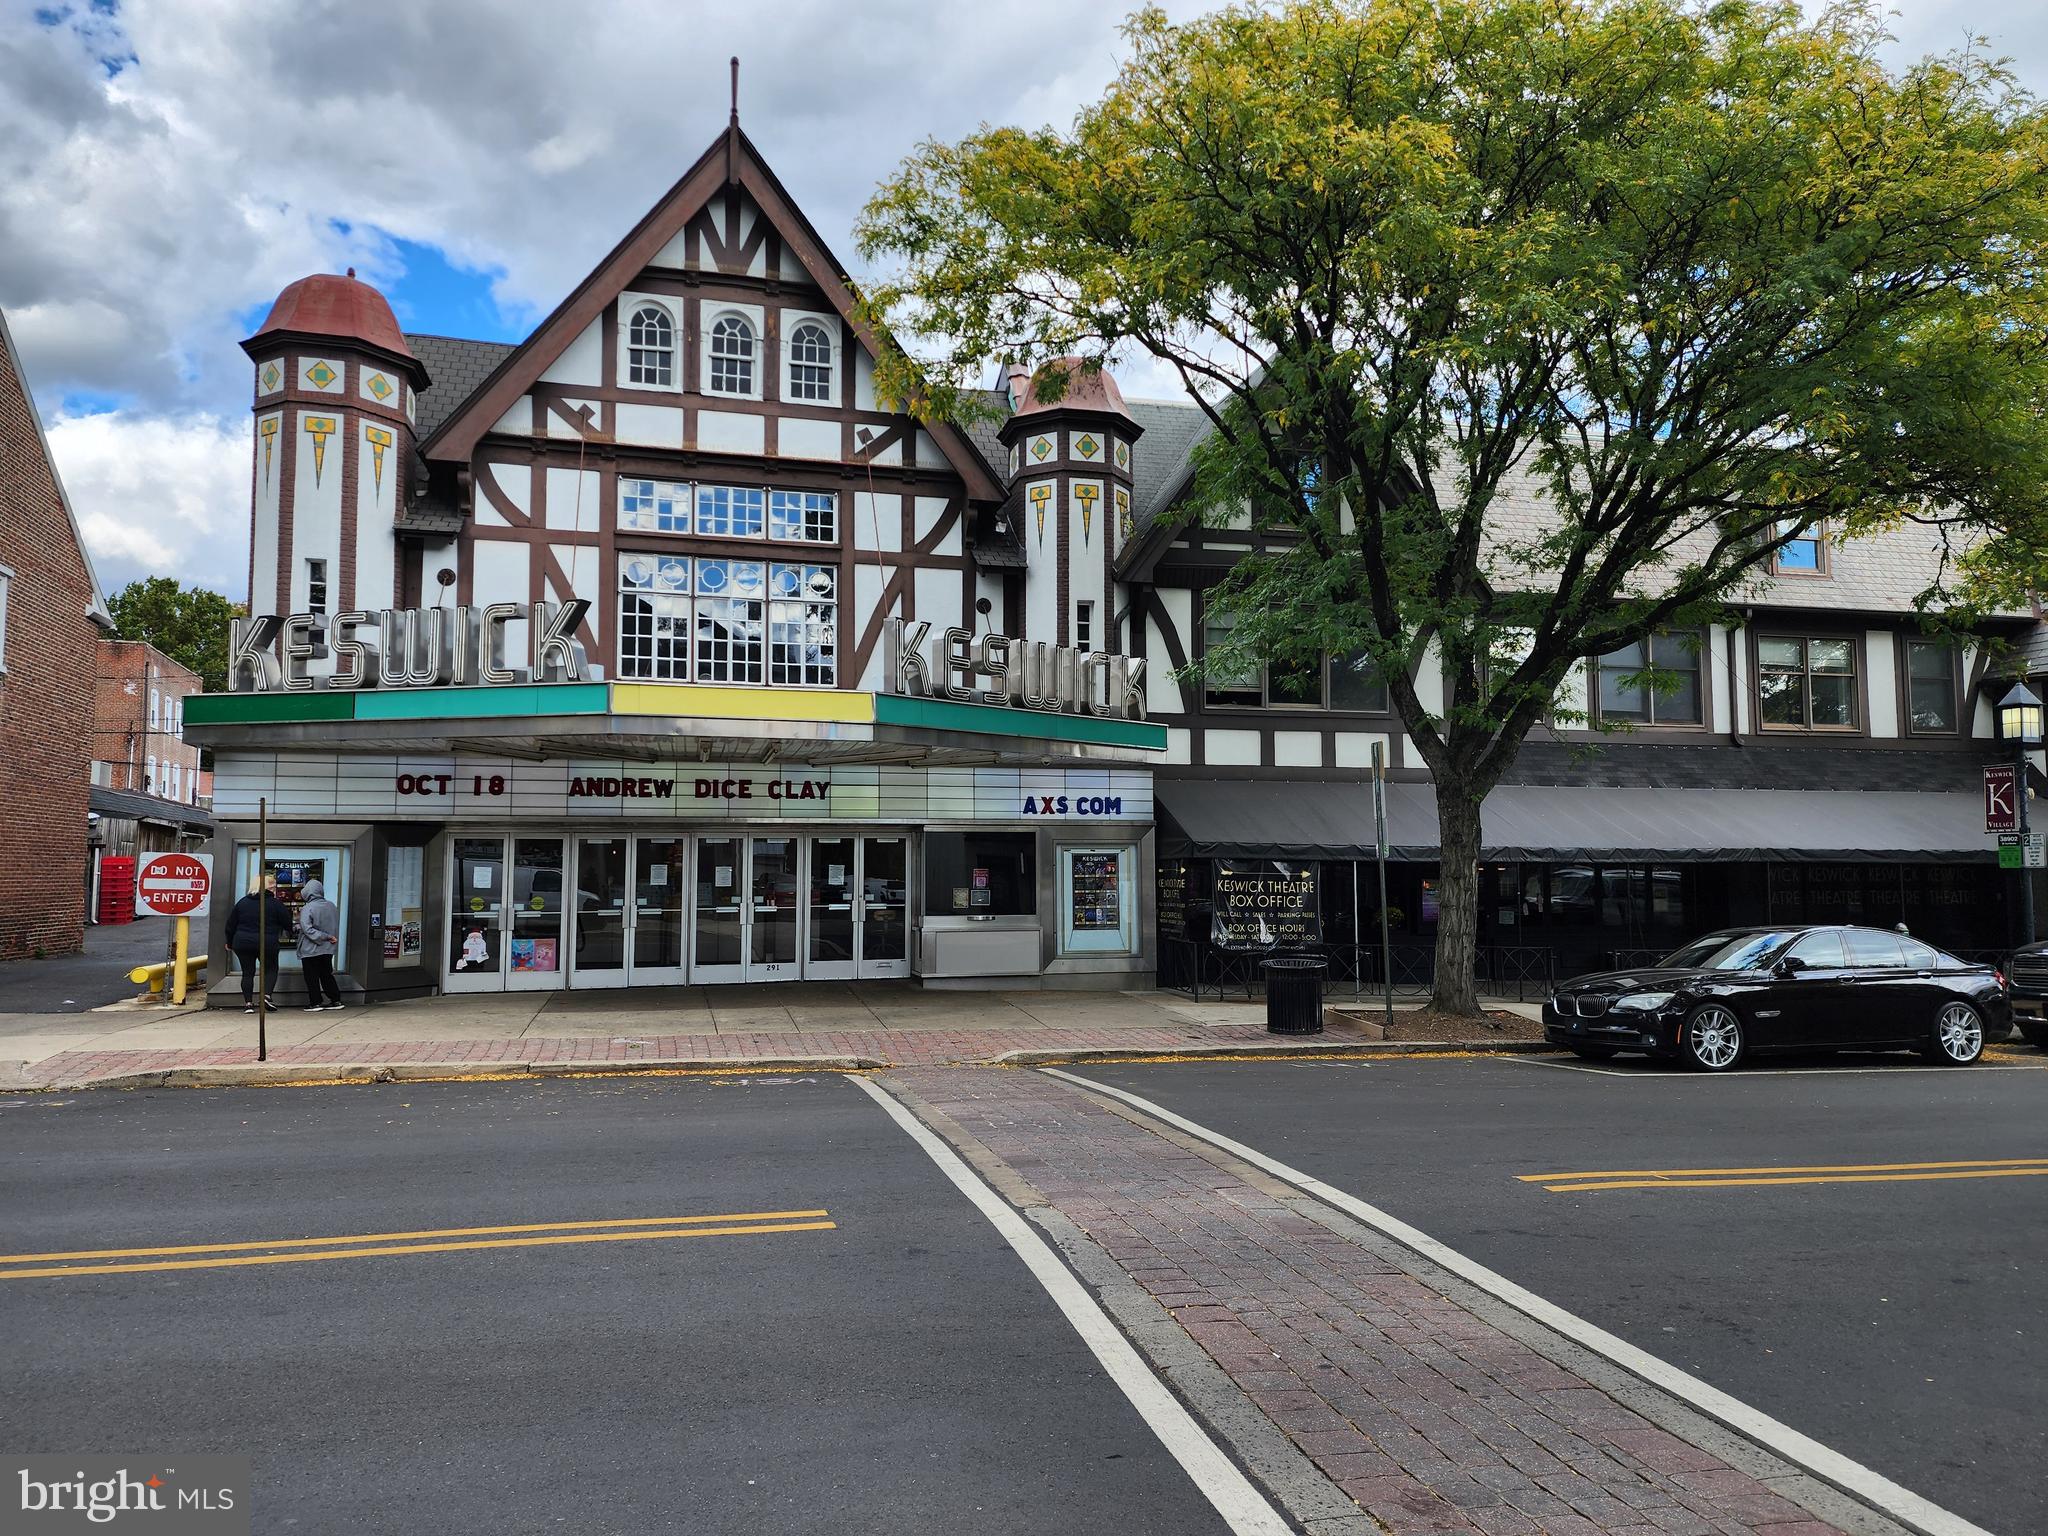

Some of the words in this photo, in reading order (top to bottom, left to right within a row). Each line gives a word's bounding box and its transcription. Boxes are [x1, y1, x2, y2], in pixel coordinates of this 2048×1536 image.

[228, 599, 592, 692] KESWICK
[885, 616, 1148, 720] KESWICK
[396, 774, 452, 796] OCT
[473, 775, 505, 796] 18
[568, 776, 674, 799] ANDREW
[694, 778, 752, 799] DICE
[767, 780, 831, 801] CLAY
[1022, 796, 1069, 815] AXS
[1076, 796, 1122, 815] COM
[1987, 782, 2012, 815] K
[1987, 820, 2013, 828] VILLAGE
[175, 865, 201, 877] NOT
[1217, 879, 1264, 893] KESWICK
[1267, 881, 1314, 893] THEATRE
[153, 892, 193, 903] ENTER
[1229, 894, 1254, 907] BOX
[1257, 895, 1303, 908] OFFICE
[1228, 923, 1245, 932] BOX
